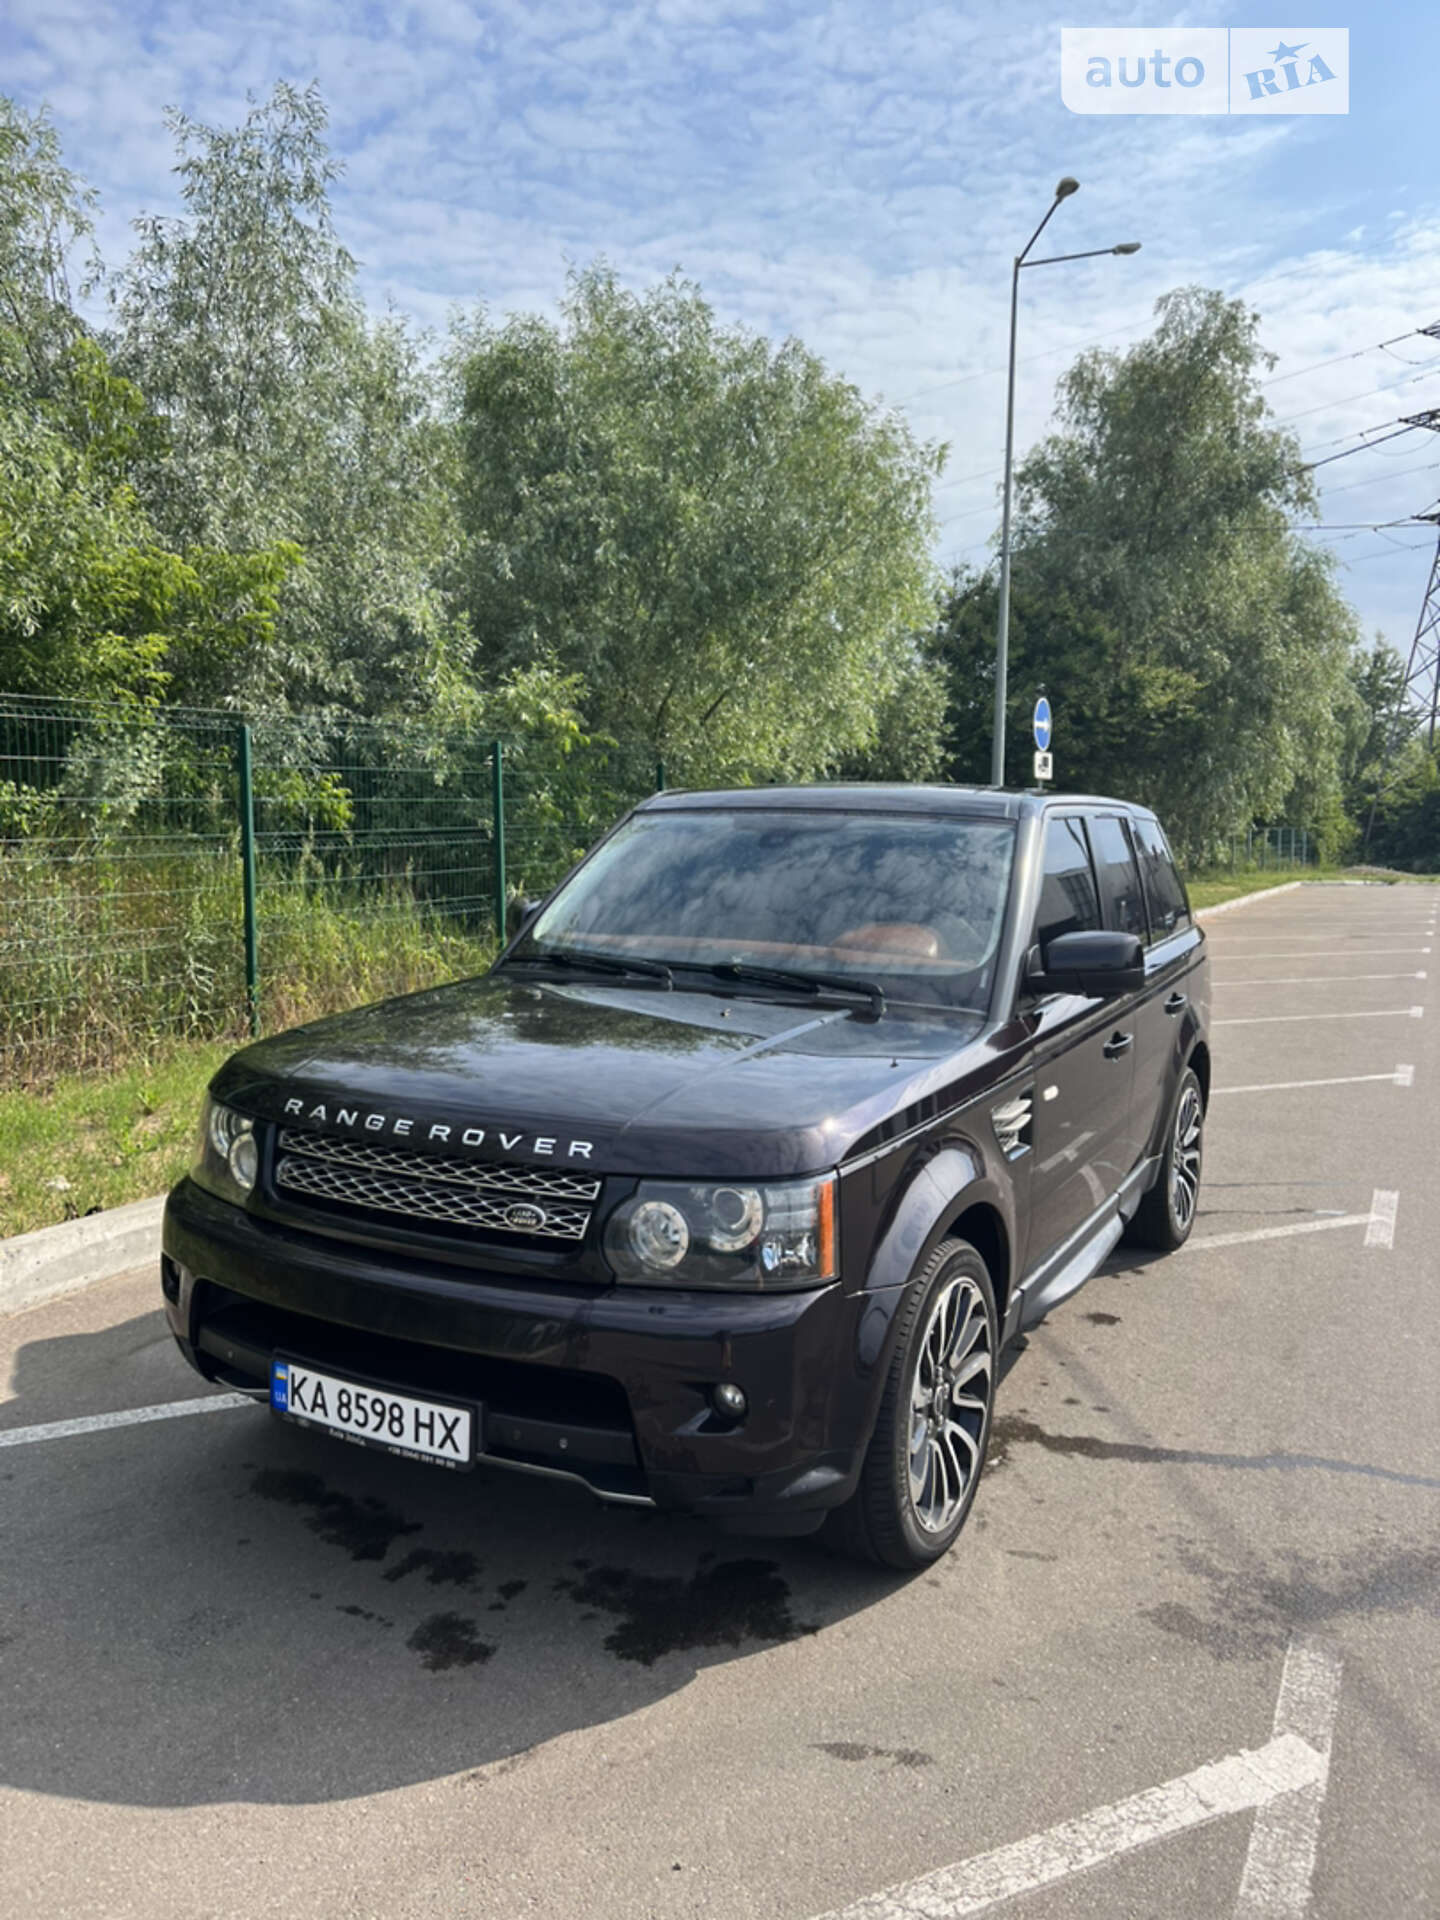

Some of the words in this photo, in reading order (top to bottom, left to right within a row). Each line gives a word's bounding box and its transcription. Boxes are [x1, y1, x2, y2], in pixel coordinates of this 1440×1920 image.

[285, 1098, 414, 1136] RANGE
[428, 1125, 594, 1158] ROVER
[275, 1391, 287, 1403] UA
[291, 1372, 329, 1418] KA
[337, 1388, 404, 1438] 8598
[414, 1407, 461, 1454] HX
